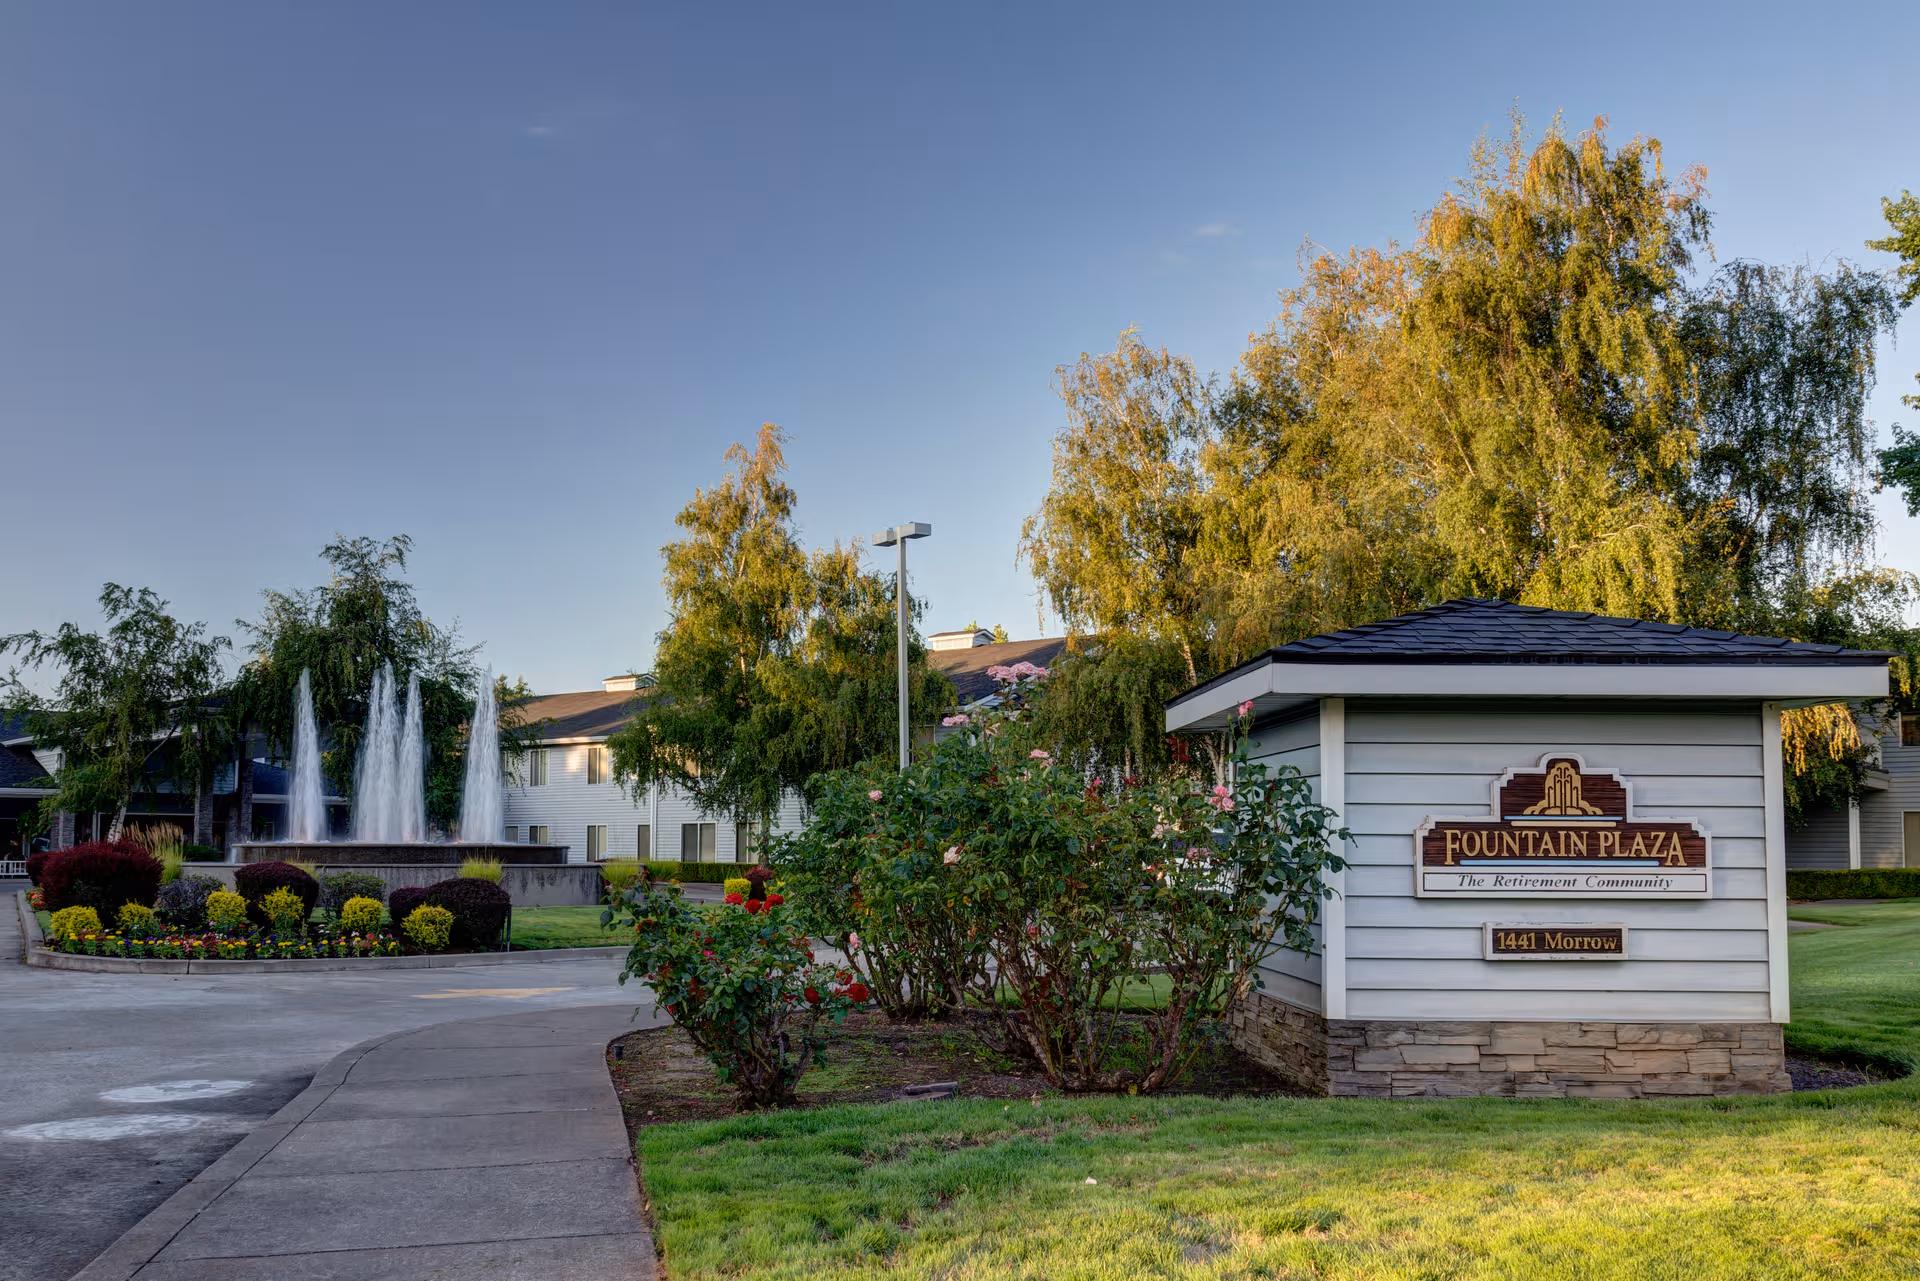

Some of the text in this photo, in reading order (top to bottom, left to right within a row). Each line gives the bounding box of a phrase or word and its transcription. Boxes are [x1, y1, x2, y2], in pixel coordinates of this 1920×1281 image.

[1444, 829, 1687, 866] FOUNTAIN PLAZA
[1458, 874, 1673, 890] The Retirement Community
[1497, 932, 1618, 950] 1441 Morrow
